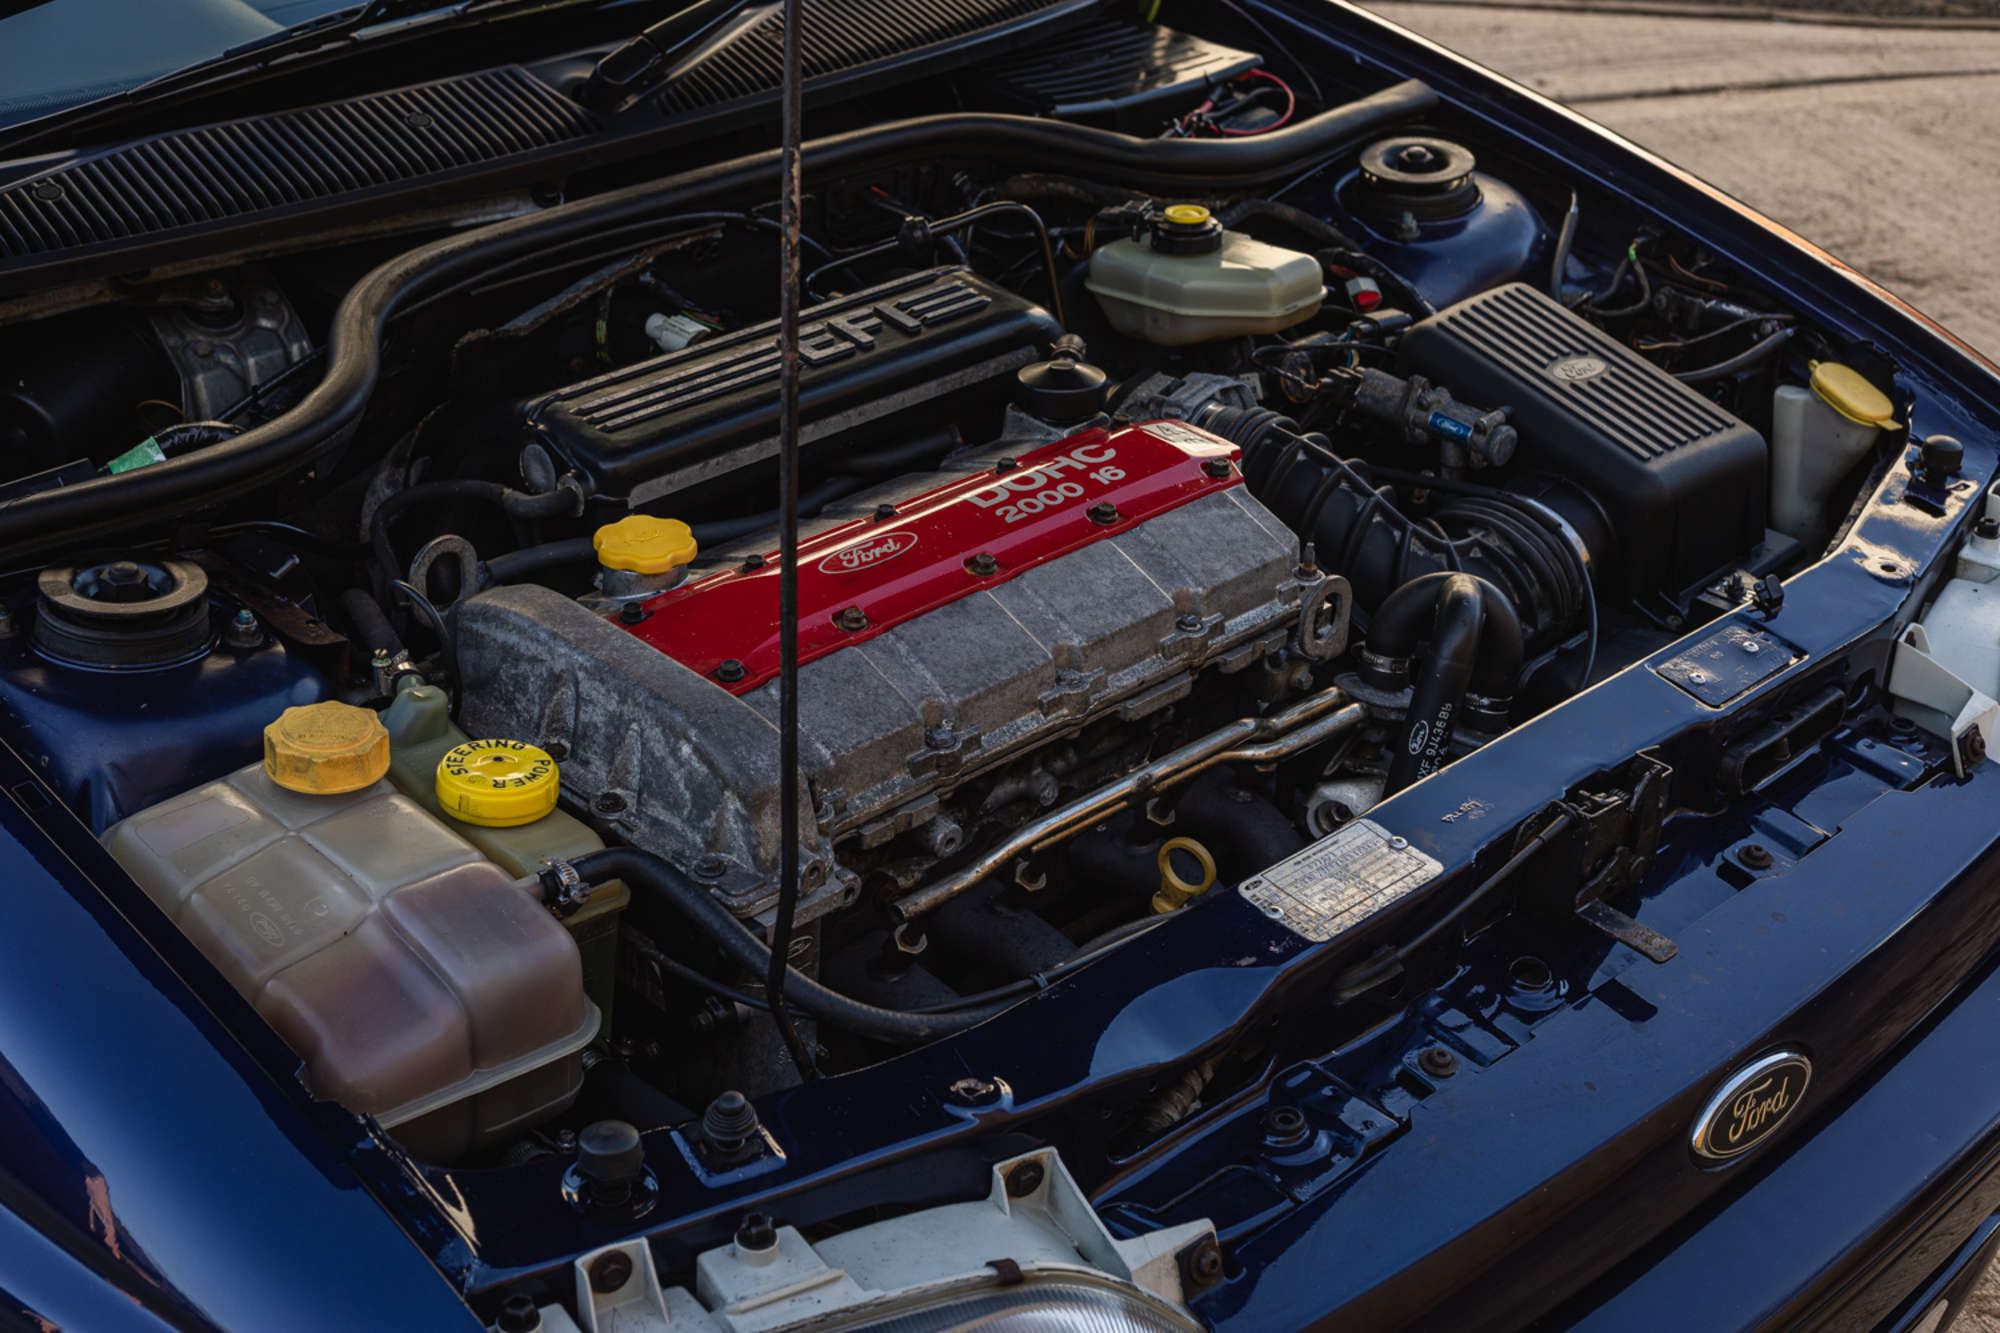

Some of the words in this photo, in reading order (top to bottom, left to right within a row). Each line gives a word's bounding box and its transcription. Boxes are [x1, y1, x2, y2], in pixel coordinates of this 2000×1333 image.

[795, 303, 922, 364] EFI
[968, 444, 1117, 509] DOHC
[995, 481, 1084, 524] 2000
[1089, 465, 1127, 485] 16
[838, 538, 901, 568] Ford
[446, 740, 527, 776] STEERING
[492, 759, 552, 789] POWER
[1728, 1075, 1790, 1143] Ford
